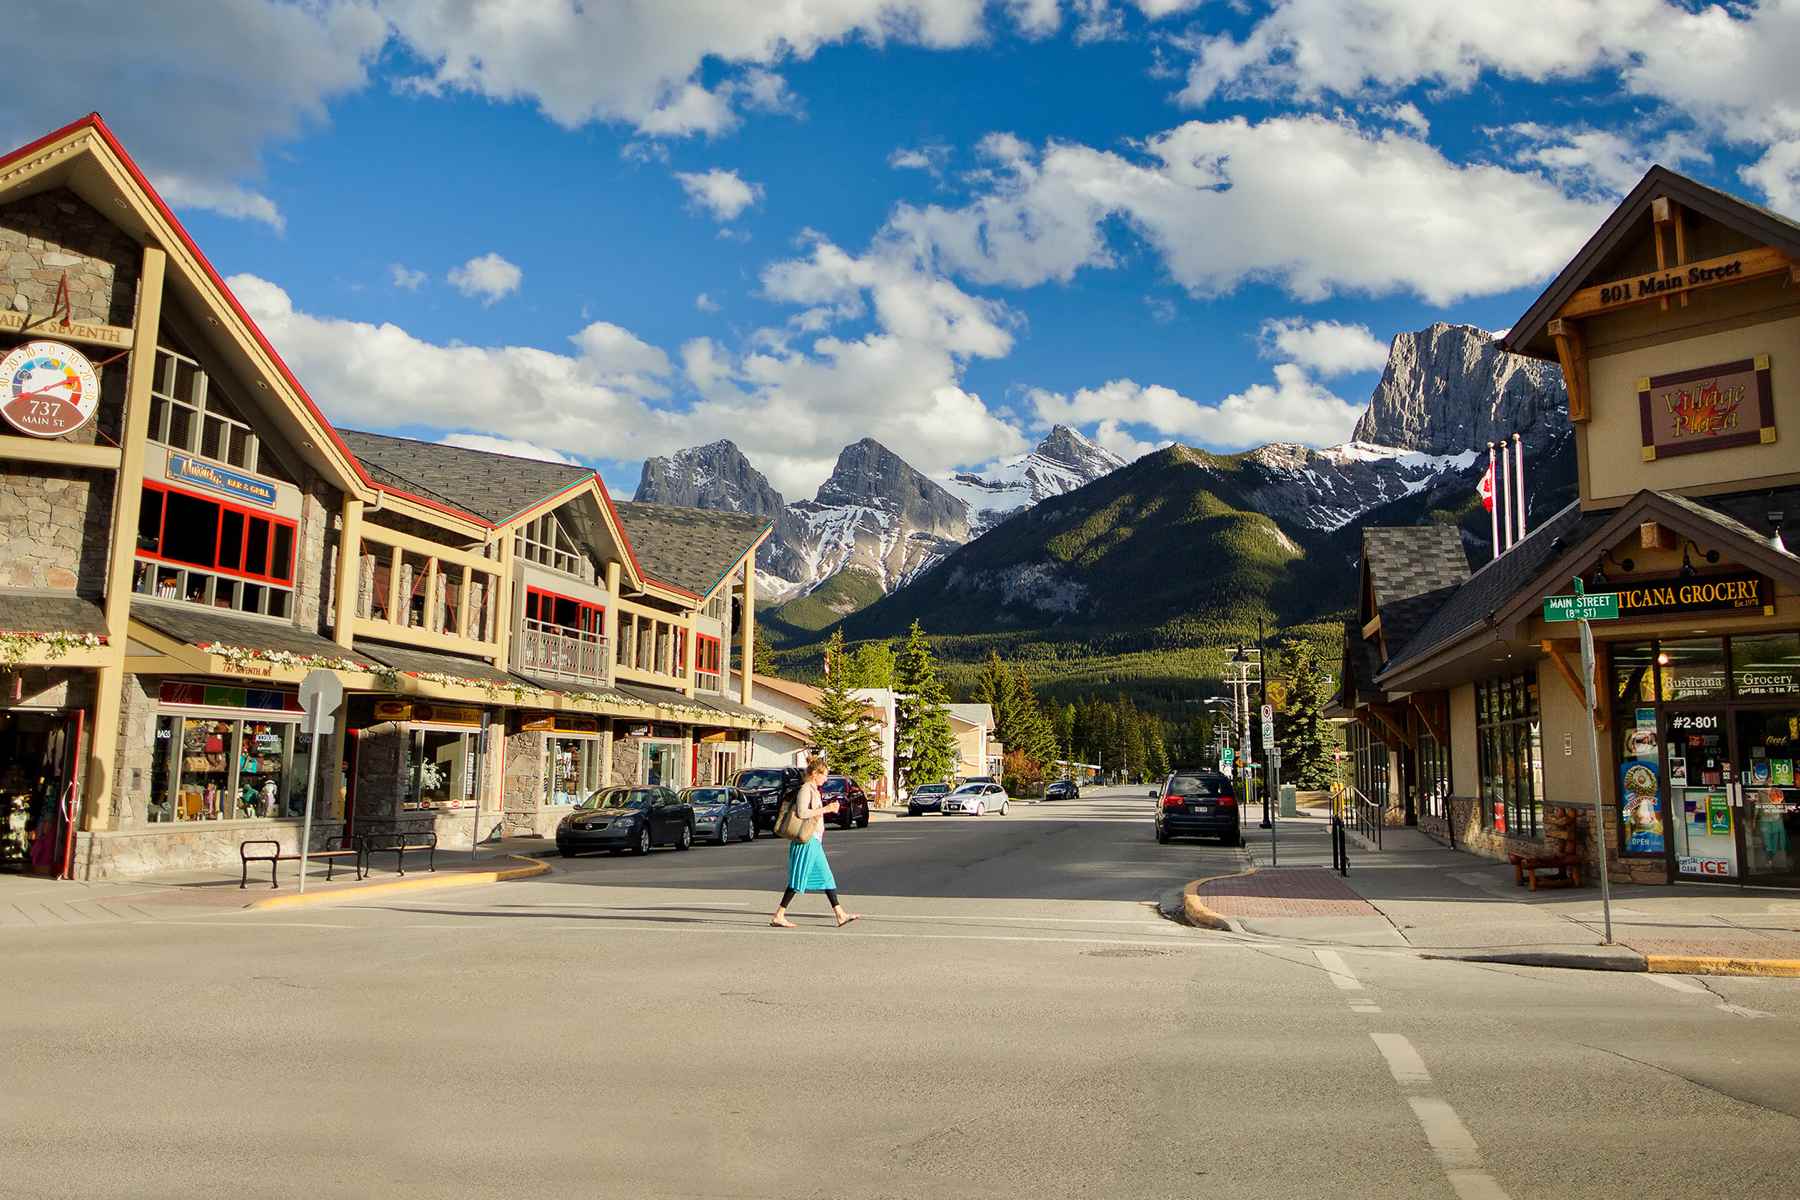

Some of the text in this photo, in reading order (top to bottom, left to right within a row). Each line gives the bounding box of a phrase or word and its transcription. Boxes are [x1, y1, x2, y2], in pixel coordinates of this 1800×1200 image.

[1600, 260, 1742, 303] 801 Main Street
[0, 313, 25, 328] AIN
[48, 320, 121, 342] SEVENTH
[1662, 383, 1745, 415] Village
[29, 400, 61, 417] 737
[22, 415, 49, 425] MAIN
[1671, 412, 1737, 438] Plaza
[1617, 580, 1759, 608] TICANA GROCERY
[1550, 596, 1610, 608] MAIN STREET
[1583, 607, 1597, 617] ST)
[1664, 673, 1793, 688] Rusticana Grocery
[1672, 716, 1718, 728] #2-801
[1224, 749, 1232, 758] P
[1775, 764, 1789, 774] 50
[1699, 861, 1728, 874] ICE
